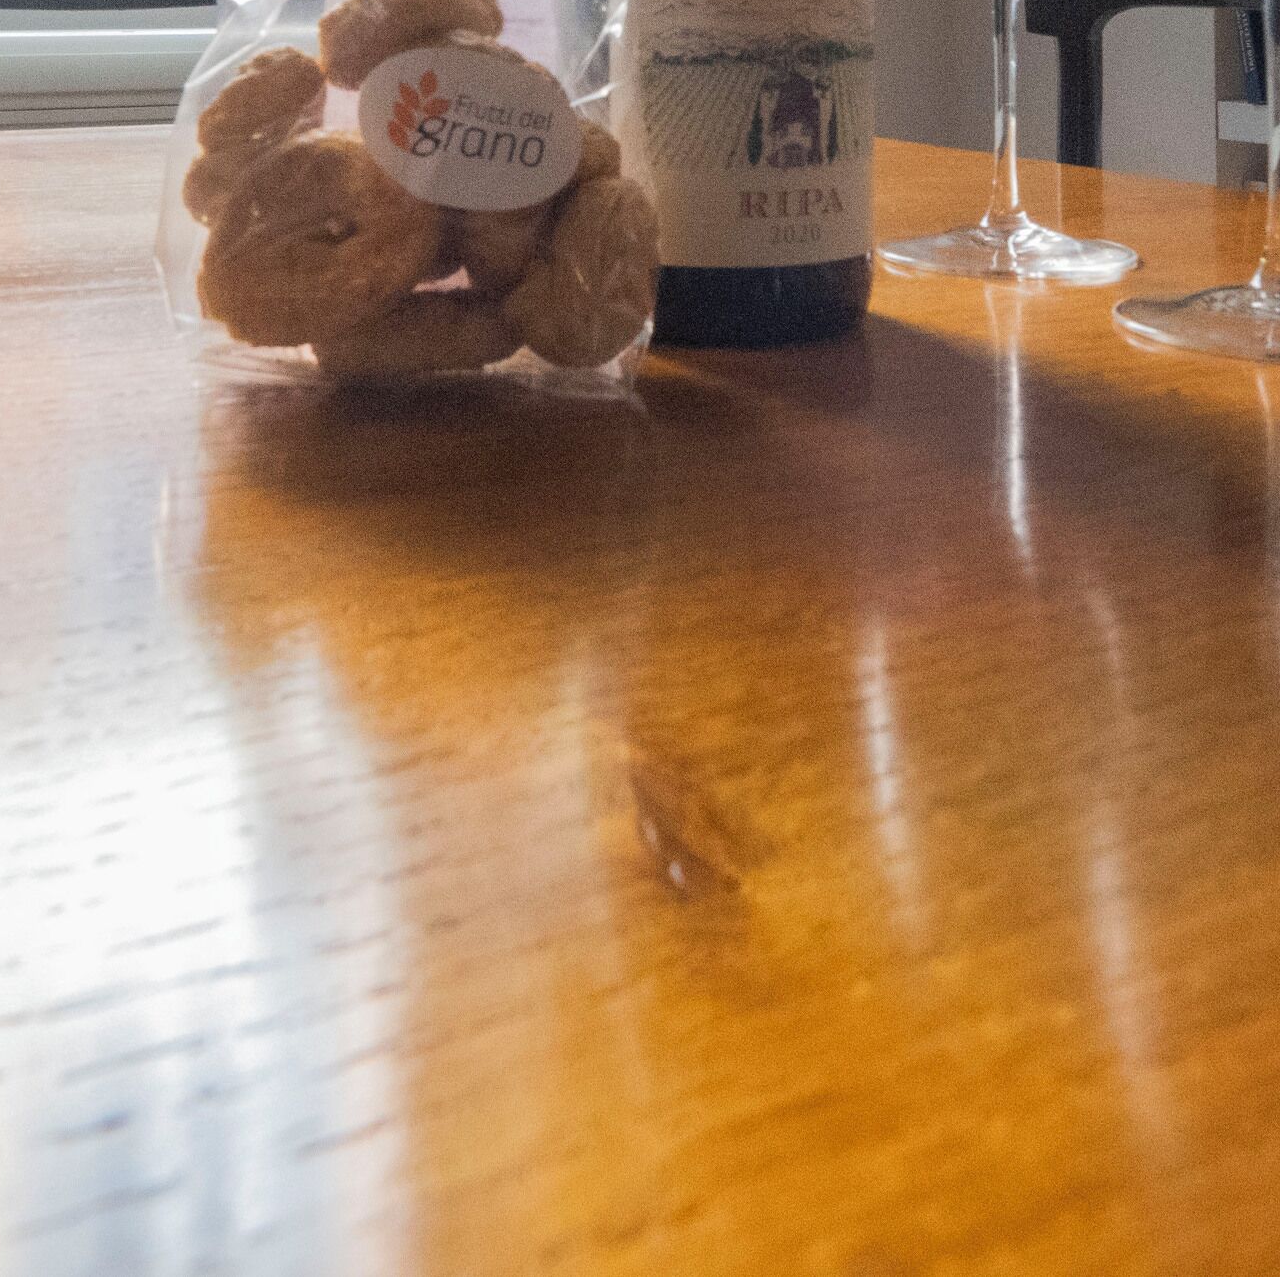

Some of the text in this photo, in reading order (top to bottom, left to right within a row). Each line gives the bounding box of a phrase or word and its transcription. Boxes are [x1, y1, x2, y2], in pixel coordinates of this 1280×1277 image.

[517, 109, 554, 132] del
[410, 114, 546, 168] grano
[739, 187, 845, 219] RIPA
